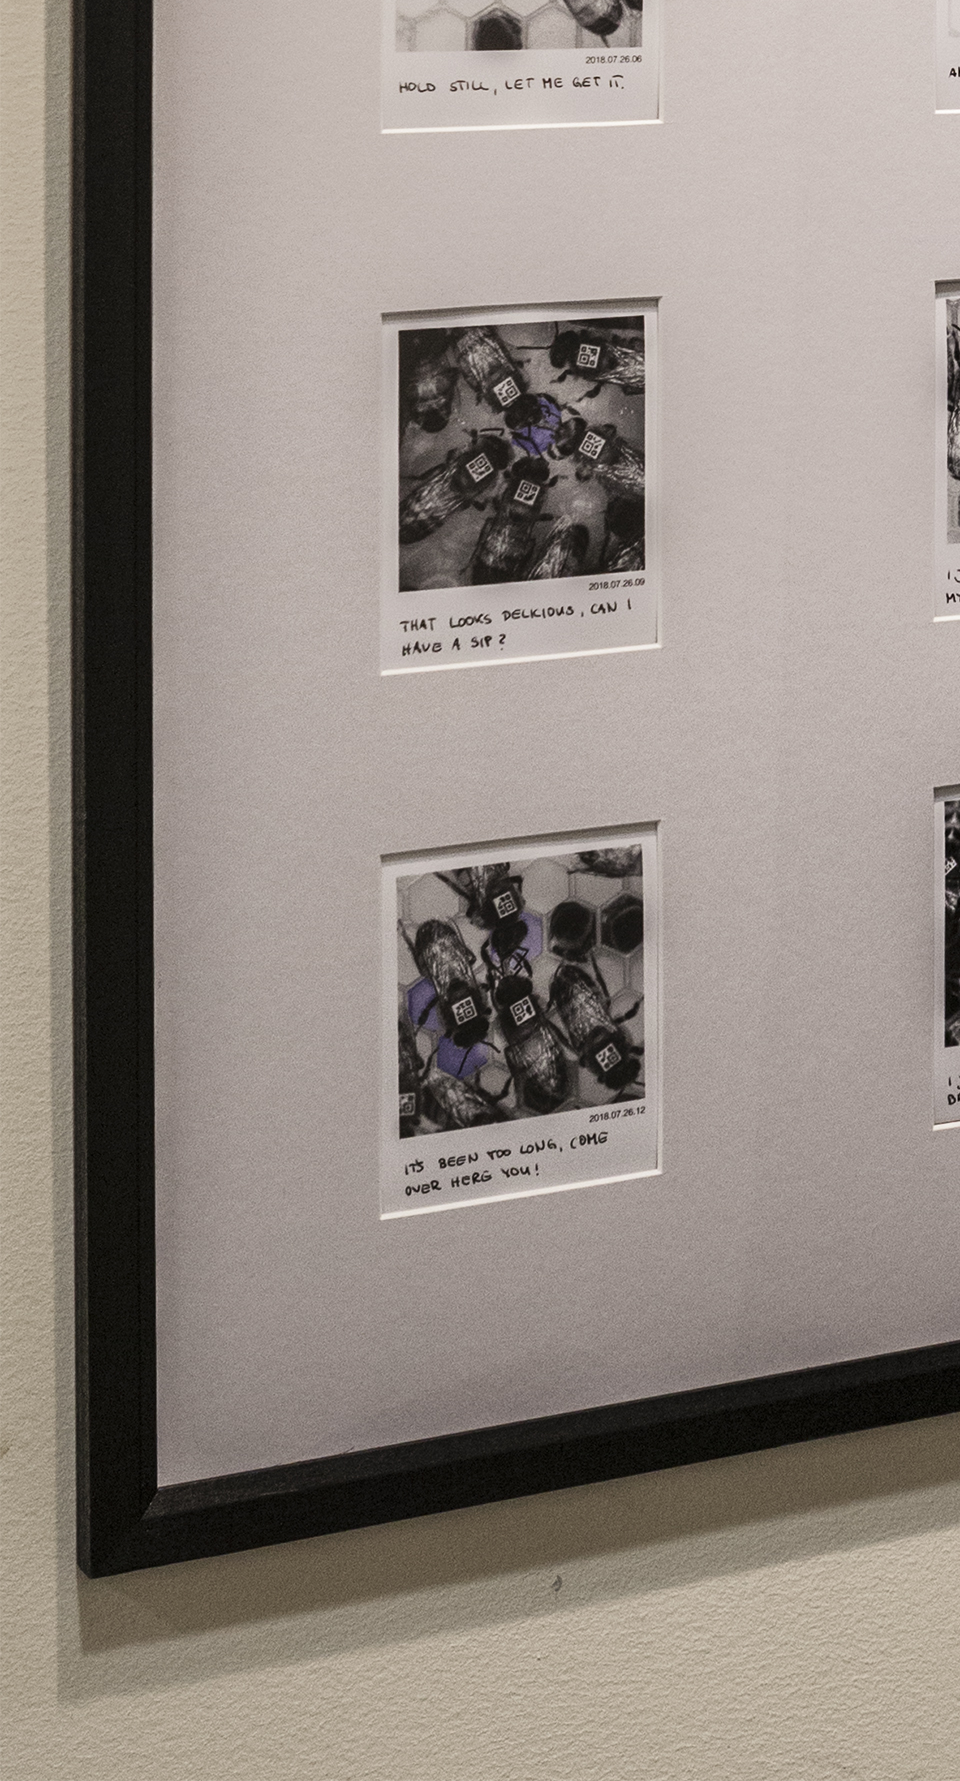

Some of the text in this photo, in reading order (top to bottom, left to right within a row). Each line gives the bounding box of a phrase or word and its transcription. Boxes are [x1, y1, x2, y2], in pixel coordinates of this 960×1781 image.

[586, 55, 642, 64] 2018.07.26.06
[399, 75, 624, 95] HOLD STILL, LET ME GET IT.
[588, 578, 645, 591] 2018.07.26.09
[399, 617, 436, 632] THAT
[449, 613, 492, 628] LOOKS
[590, 601, 617, 614] CAN
[589, 1106, 646, 1123] 2018.07.26.12
[438, 1152, 478, 1169] BEEN
[486, 1149, 511, 1160] TOO
[520, 1139, 563, 1154] LONG,
[405, 1180, 442, 1196] OVER
[500, 1163, 539, 1178] YOU!
